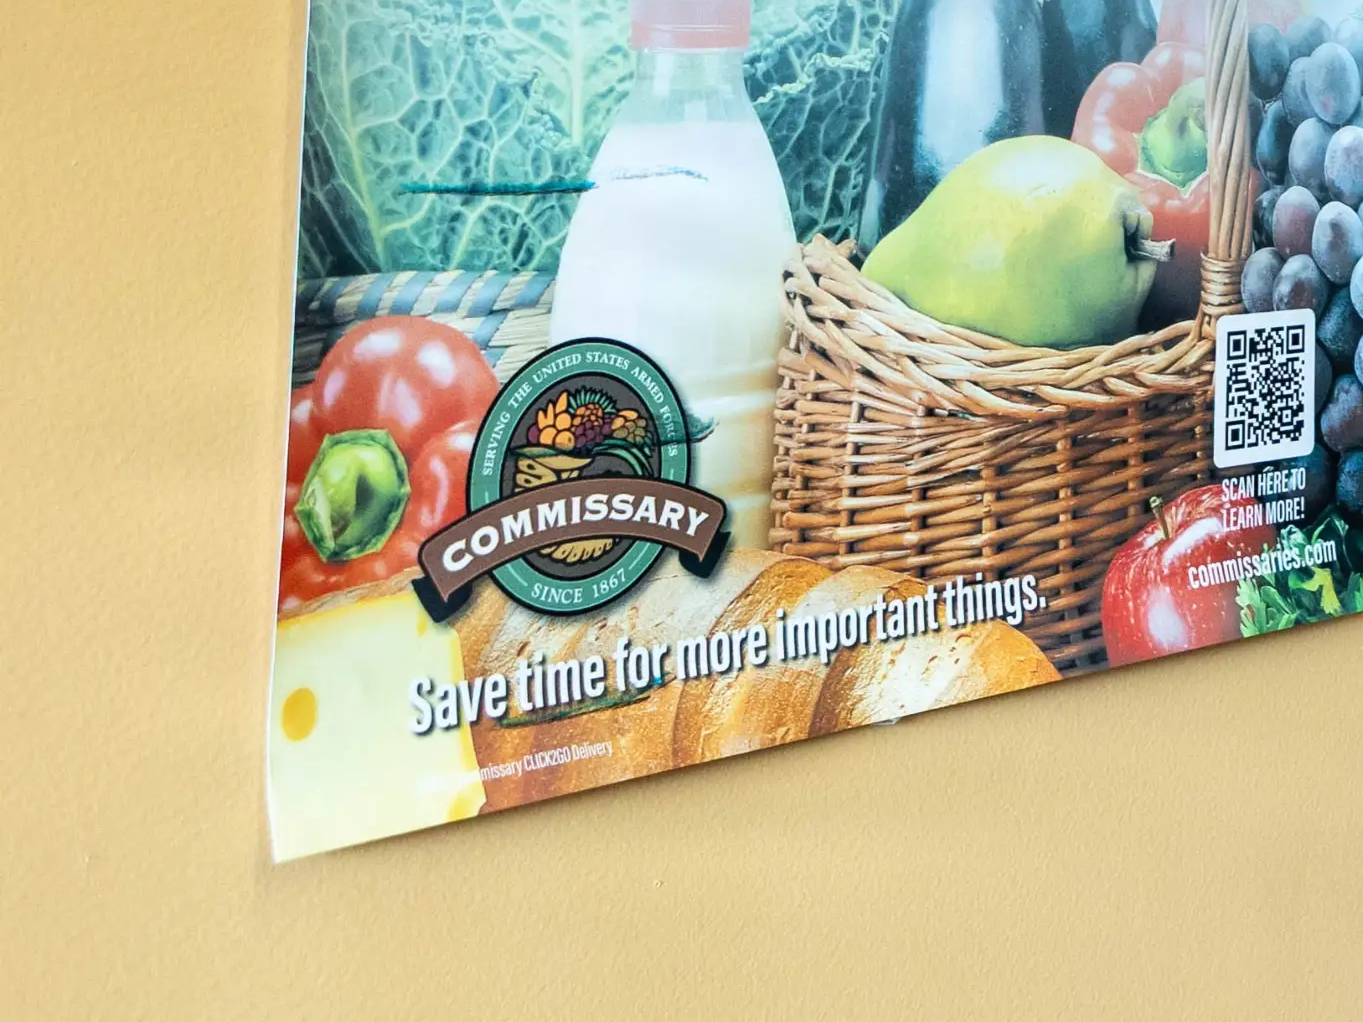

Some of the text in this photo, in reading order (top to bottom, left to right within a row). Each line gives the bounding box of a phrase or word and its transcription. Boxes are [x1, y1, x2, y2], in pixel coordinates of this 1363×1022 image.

[482, 411, 511, 476] SERVING
[508, 382, 533, 409] THE
[532, 352, 582, 385] UNITED
[585, 351, 630, 371] STATES
[630, 366, 665, 406] ARMED
[1221, 466, 1307, 503] SCAN HERE TO
[442, 492, 711, 573] COMMISSARY
[1221, 495, 1306, 533] LEARN MORE!
[530, 568, 628, 605] SINCE 1867
[1187, 538, 1338, 591] commissaries.com
[409, 572, 1048, 737] Save time for more important things.
[523, 747, 571, 772] CLICK2GO
[571, 741, 613, 761] Delivery
